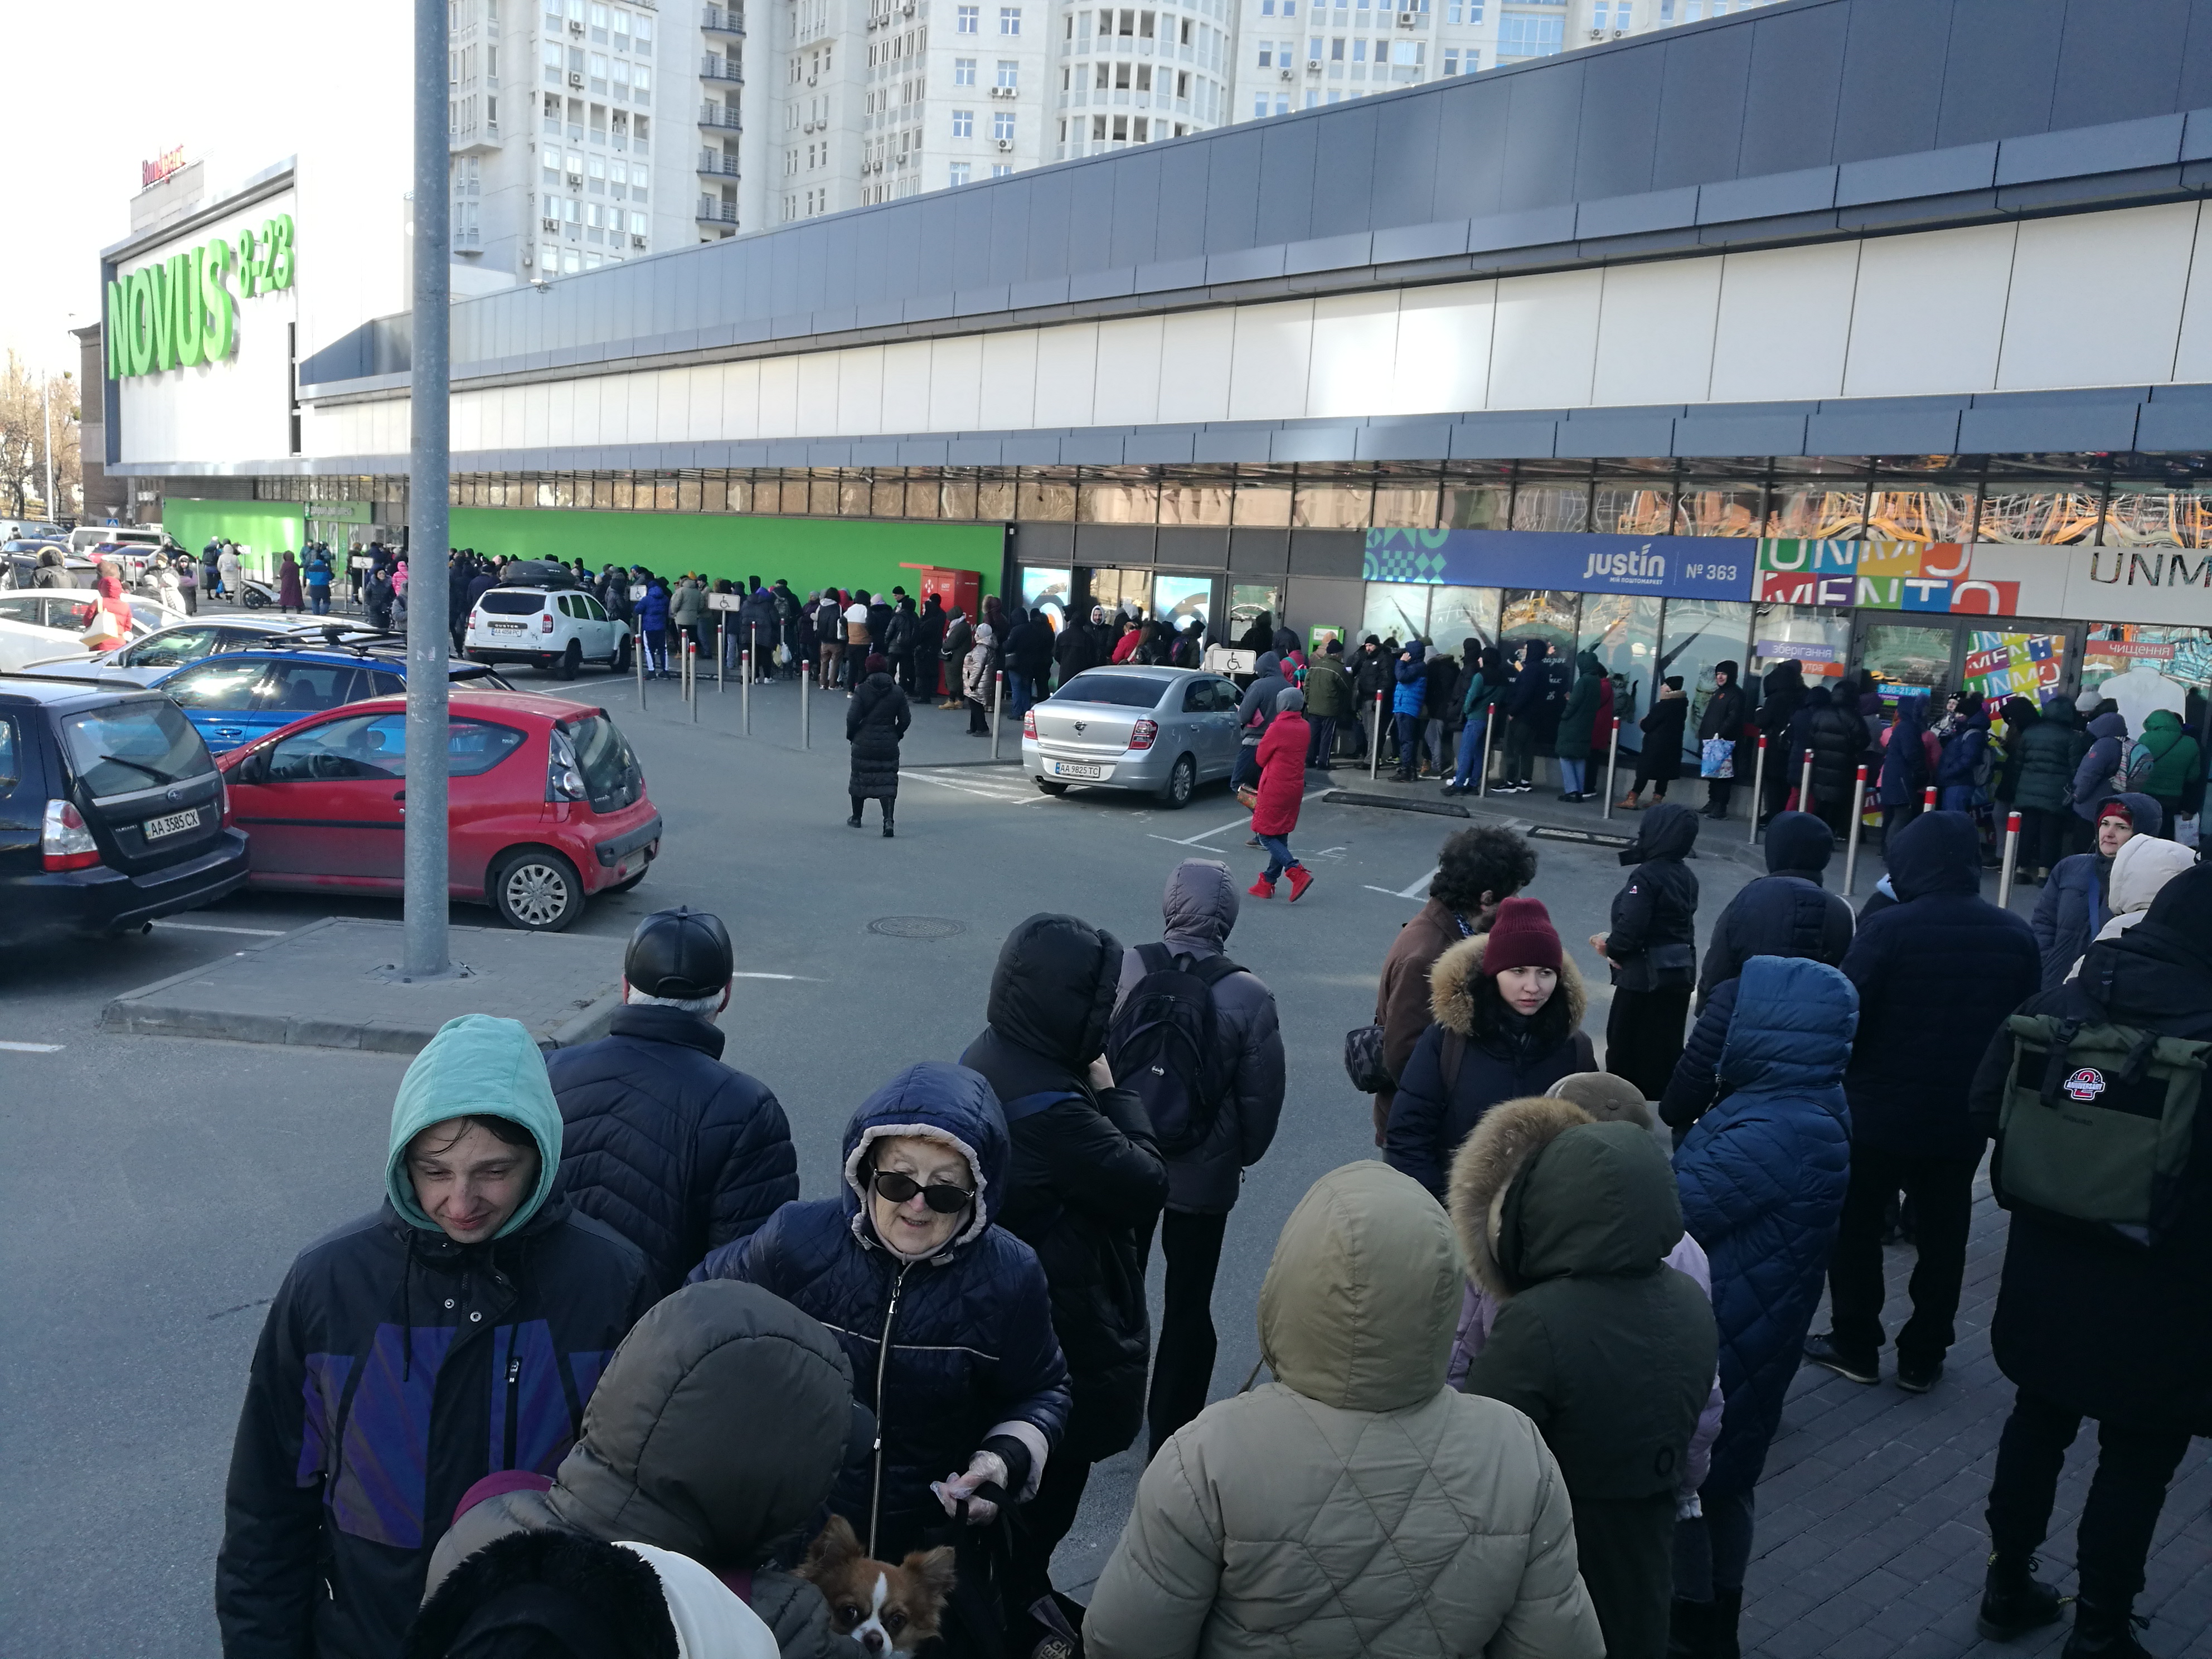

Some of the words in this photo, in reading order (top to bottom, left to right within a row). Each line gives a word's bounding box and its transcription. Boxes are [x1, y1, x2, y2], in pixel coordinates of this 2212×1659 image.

[108, 238, 234, 380] NOVUS
[237, 214, 295, 299] 8-23
[1706, 564, 1737, 581] 363
[1772, 643, 1832, 659] зберігання
[2109, 643, 2170, 656] чищення
[1801, 662, 1825, 673] утра
[151, 822, 164, 836] AA
[164, 815, 185, 832] 3585
[185, 811, 198, 826] CX
[2066, 1081, 2103, 1090] ANNIVERSARY
